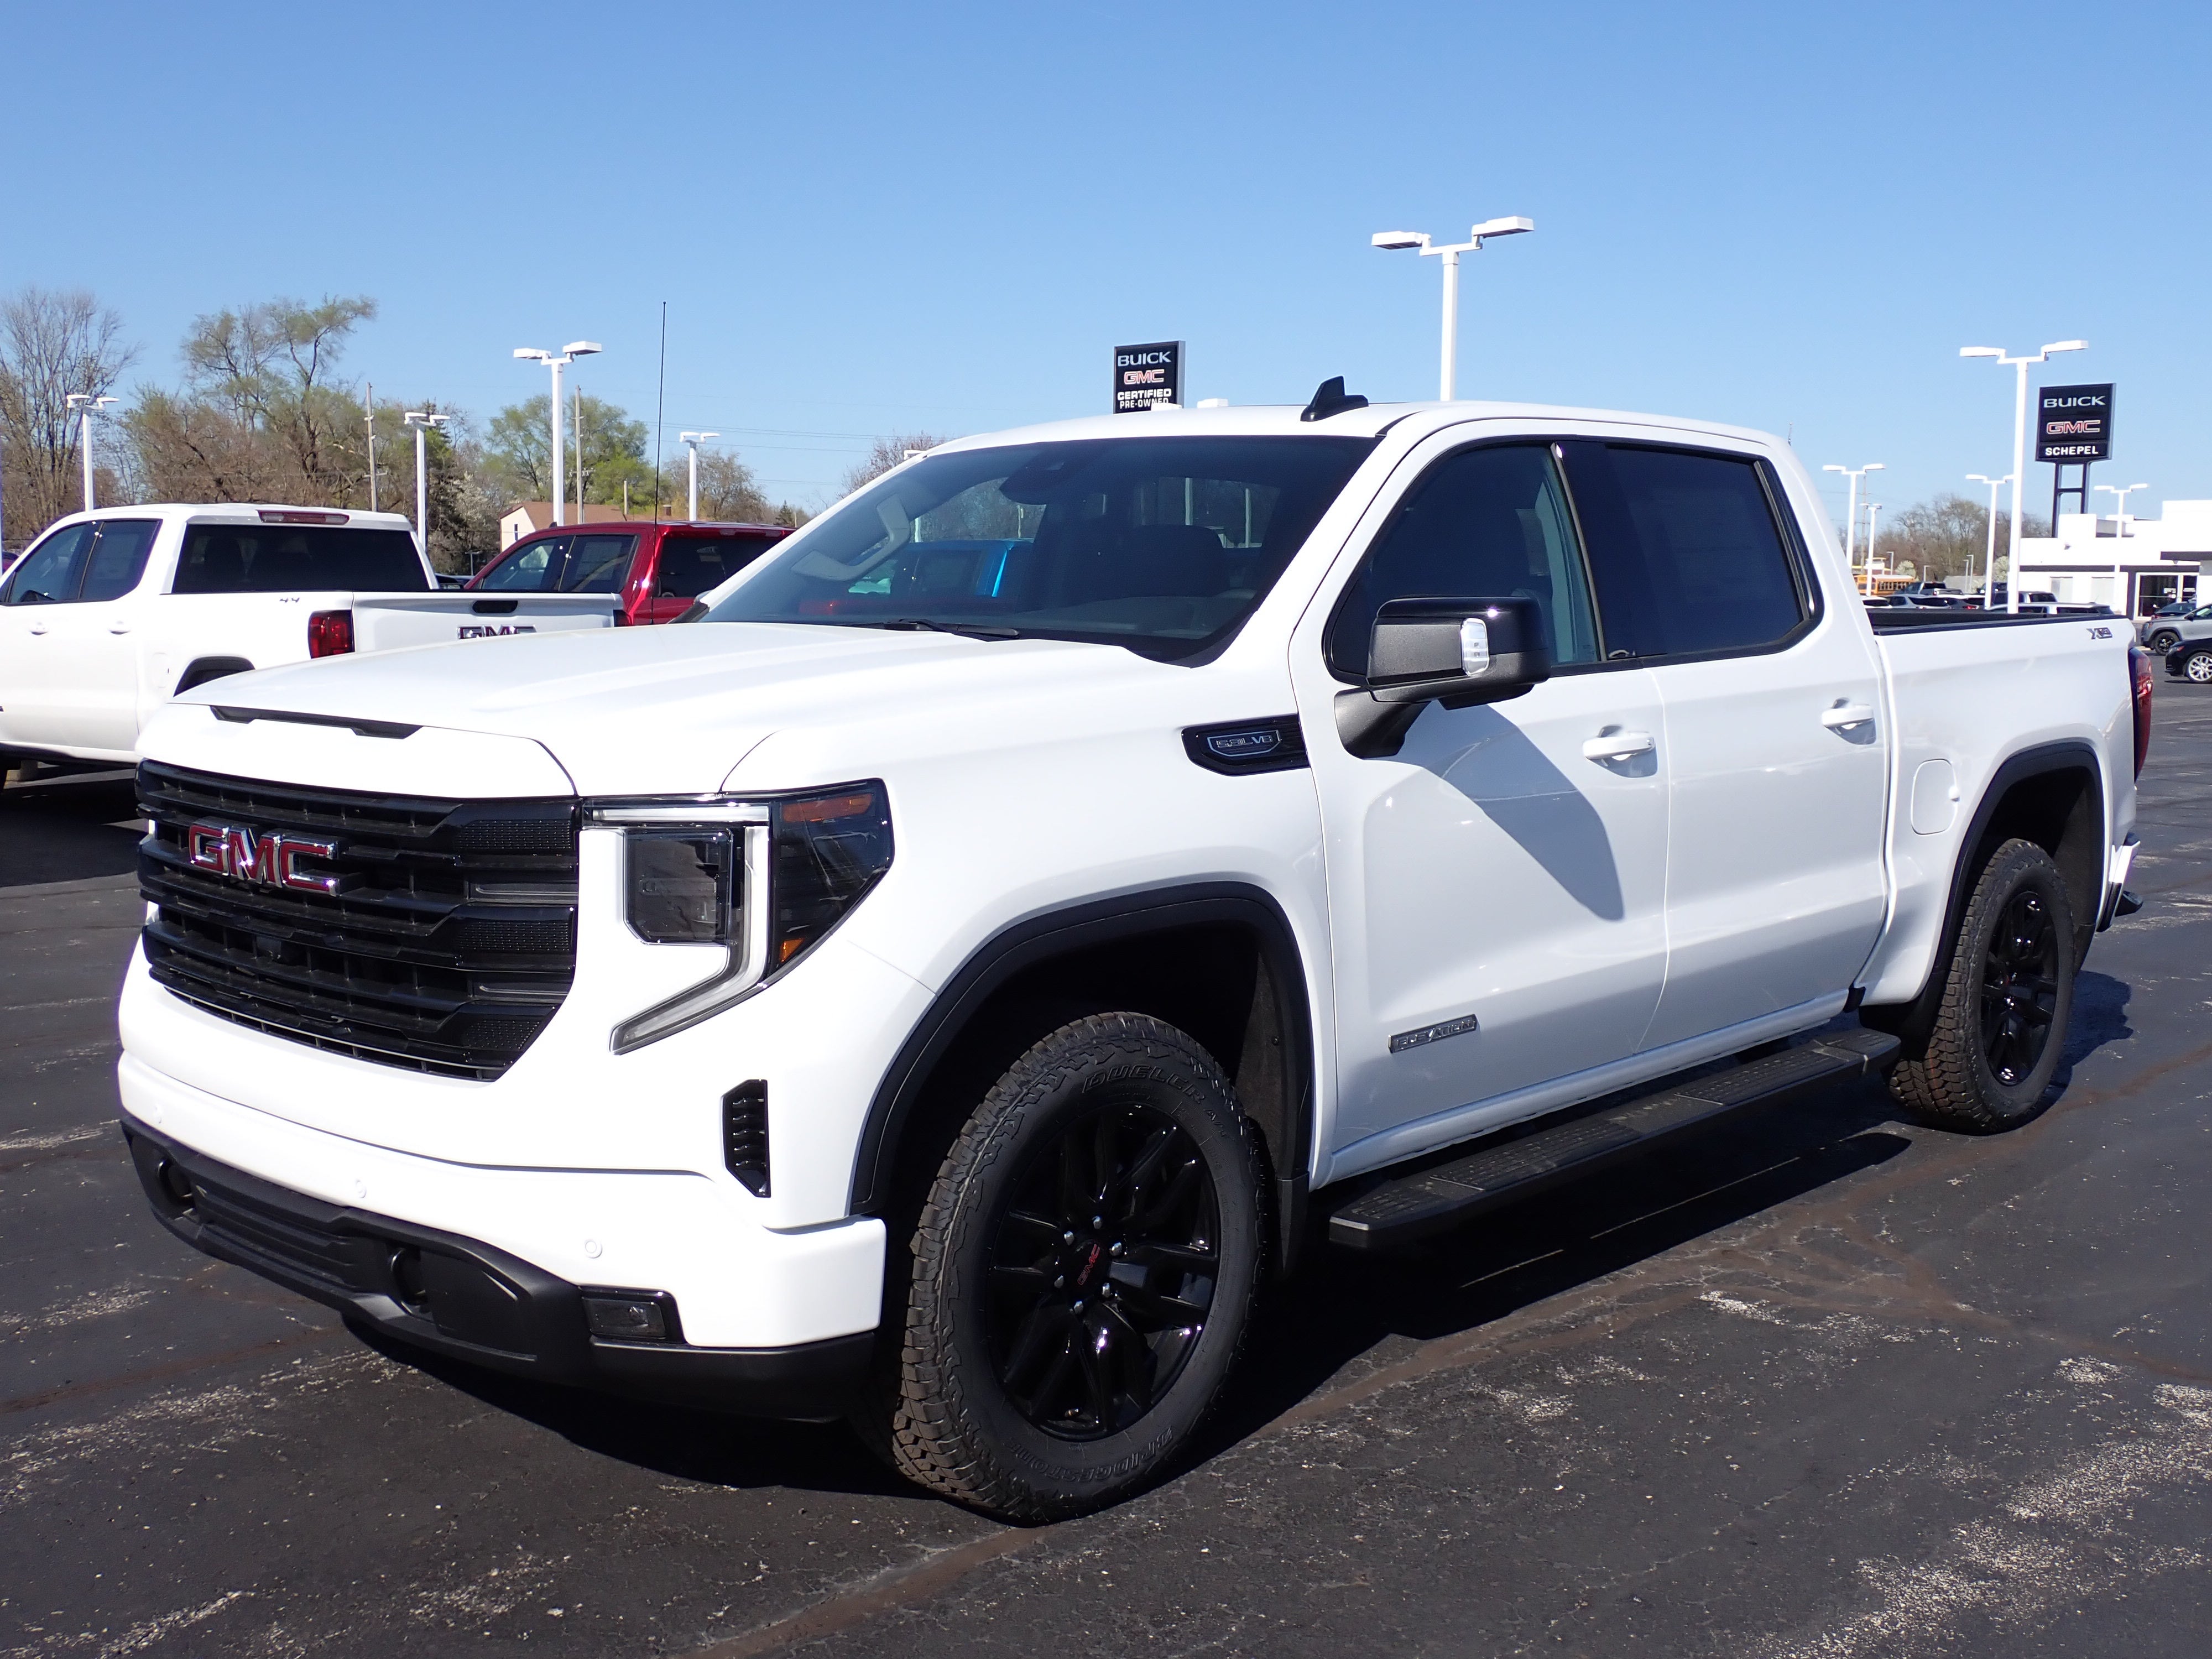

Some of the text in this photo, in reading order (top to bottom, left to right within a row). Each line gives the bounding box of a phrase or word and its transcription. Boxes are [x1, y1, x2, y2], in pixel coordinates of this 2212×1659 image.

[1118, 351, 1171, 366] BUICK
[1124, 369, 1165, 384] GMC
[1117, 388, 1172, 400] CERTIFIED
[1120, 398, 1169, 409] PRE-OWNED
[2044, 396, 2106, 408] BUICK
[2047, 420, 2100, 434] GMC
[2046, 446, 2099, 456] SCHEPEL
[188, 818, 341, 897] GMC
[1082, 1064, 1206, 1104] DUELER
[1077, 1244, 1100, 1285] GMC
